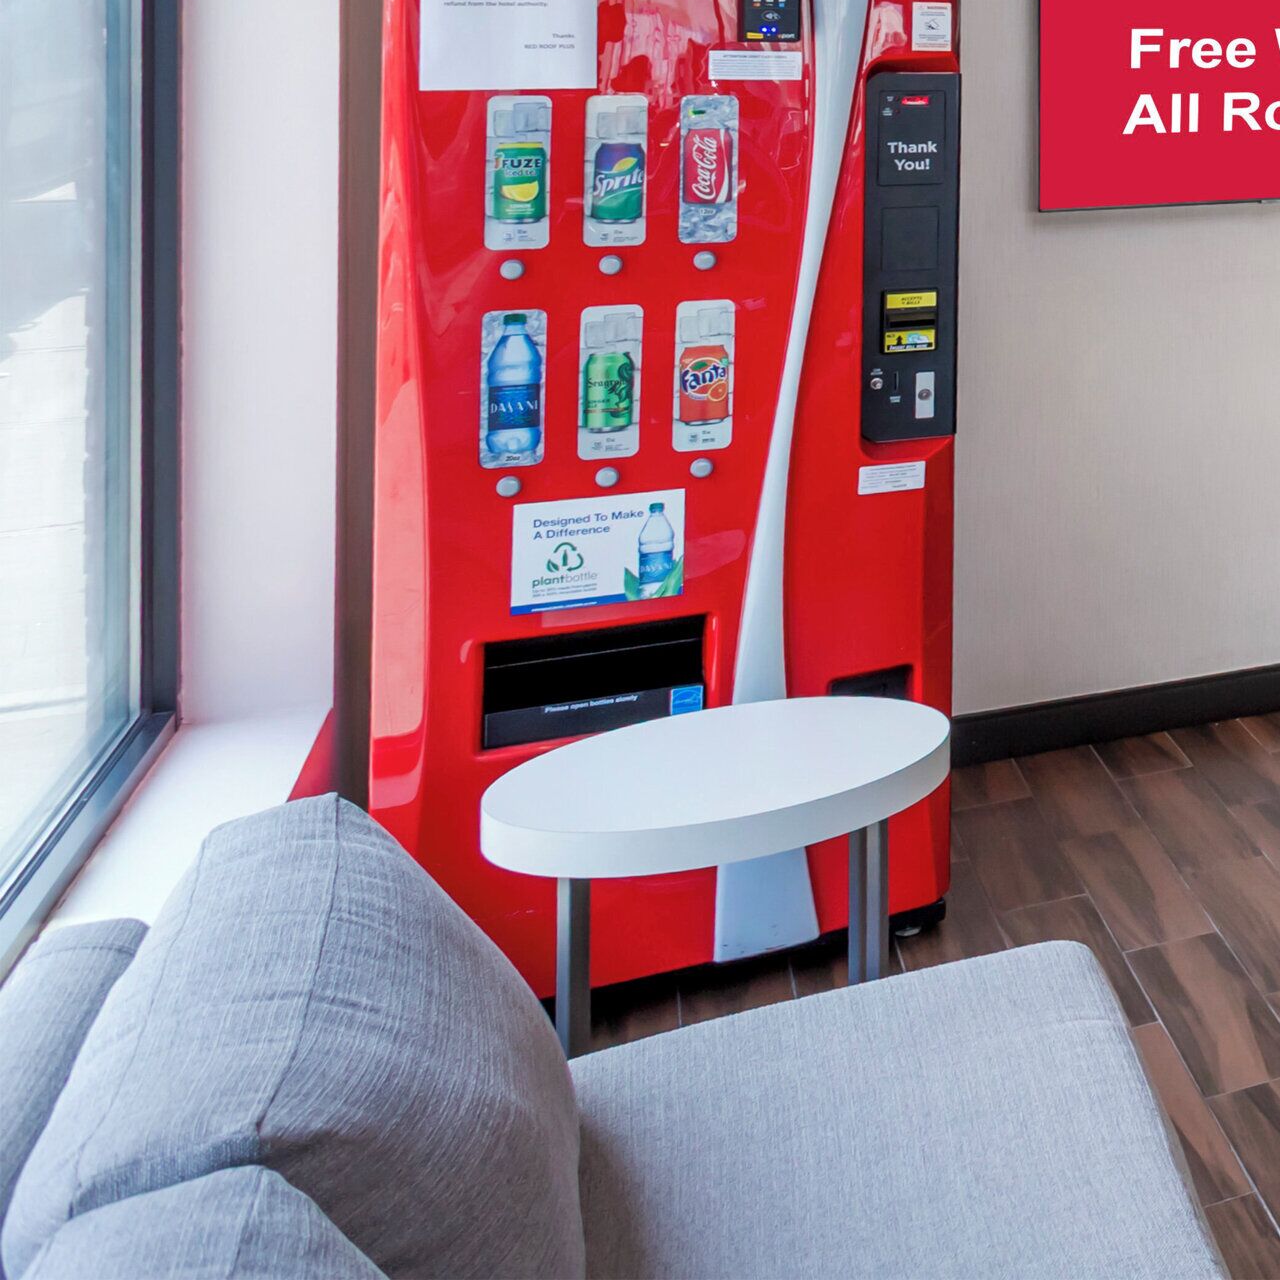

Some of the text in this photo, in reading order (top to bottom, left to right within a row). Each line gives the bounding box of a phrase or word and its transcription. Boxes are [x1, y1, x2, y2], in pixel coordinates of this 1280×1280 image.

[1130, 27, 1256, 70] Free
[1122, 92, 1200, 135] All
[887, 140, 938, 154] Thank
[502, 158, 542, 168] FUZE
[894, 158, 930, 171] You!
[594, 168, 644, 198] Sprite
[490, 399, 538, 414] DASANI
[533, 510, 644, 528] Designed To Make
[534, 526, 610, 540] A Difference
[532, 571, 598, 589] plantbottle
[544, 694, 638, 714] Please open bottles slowly
